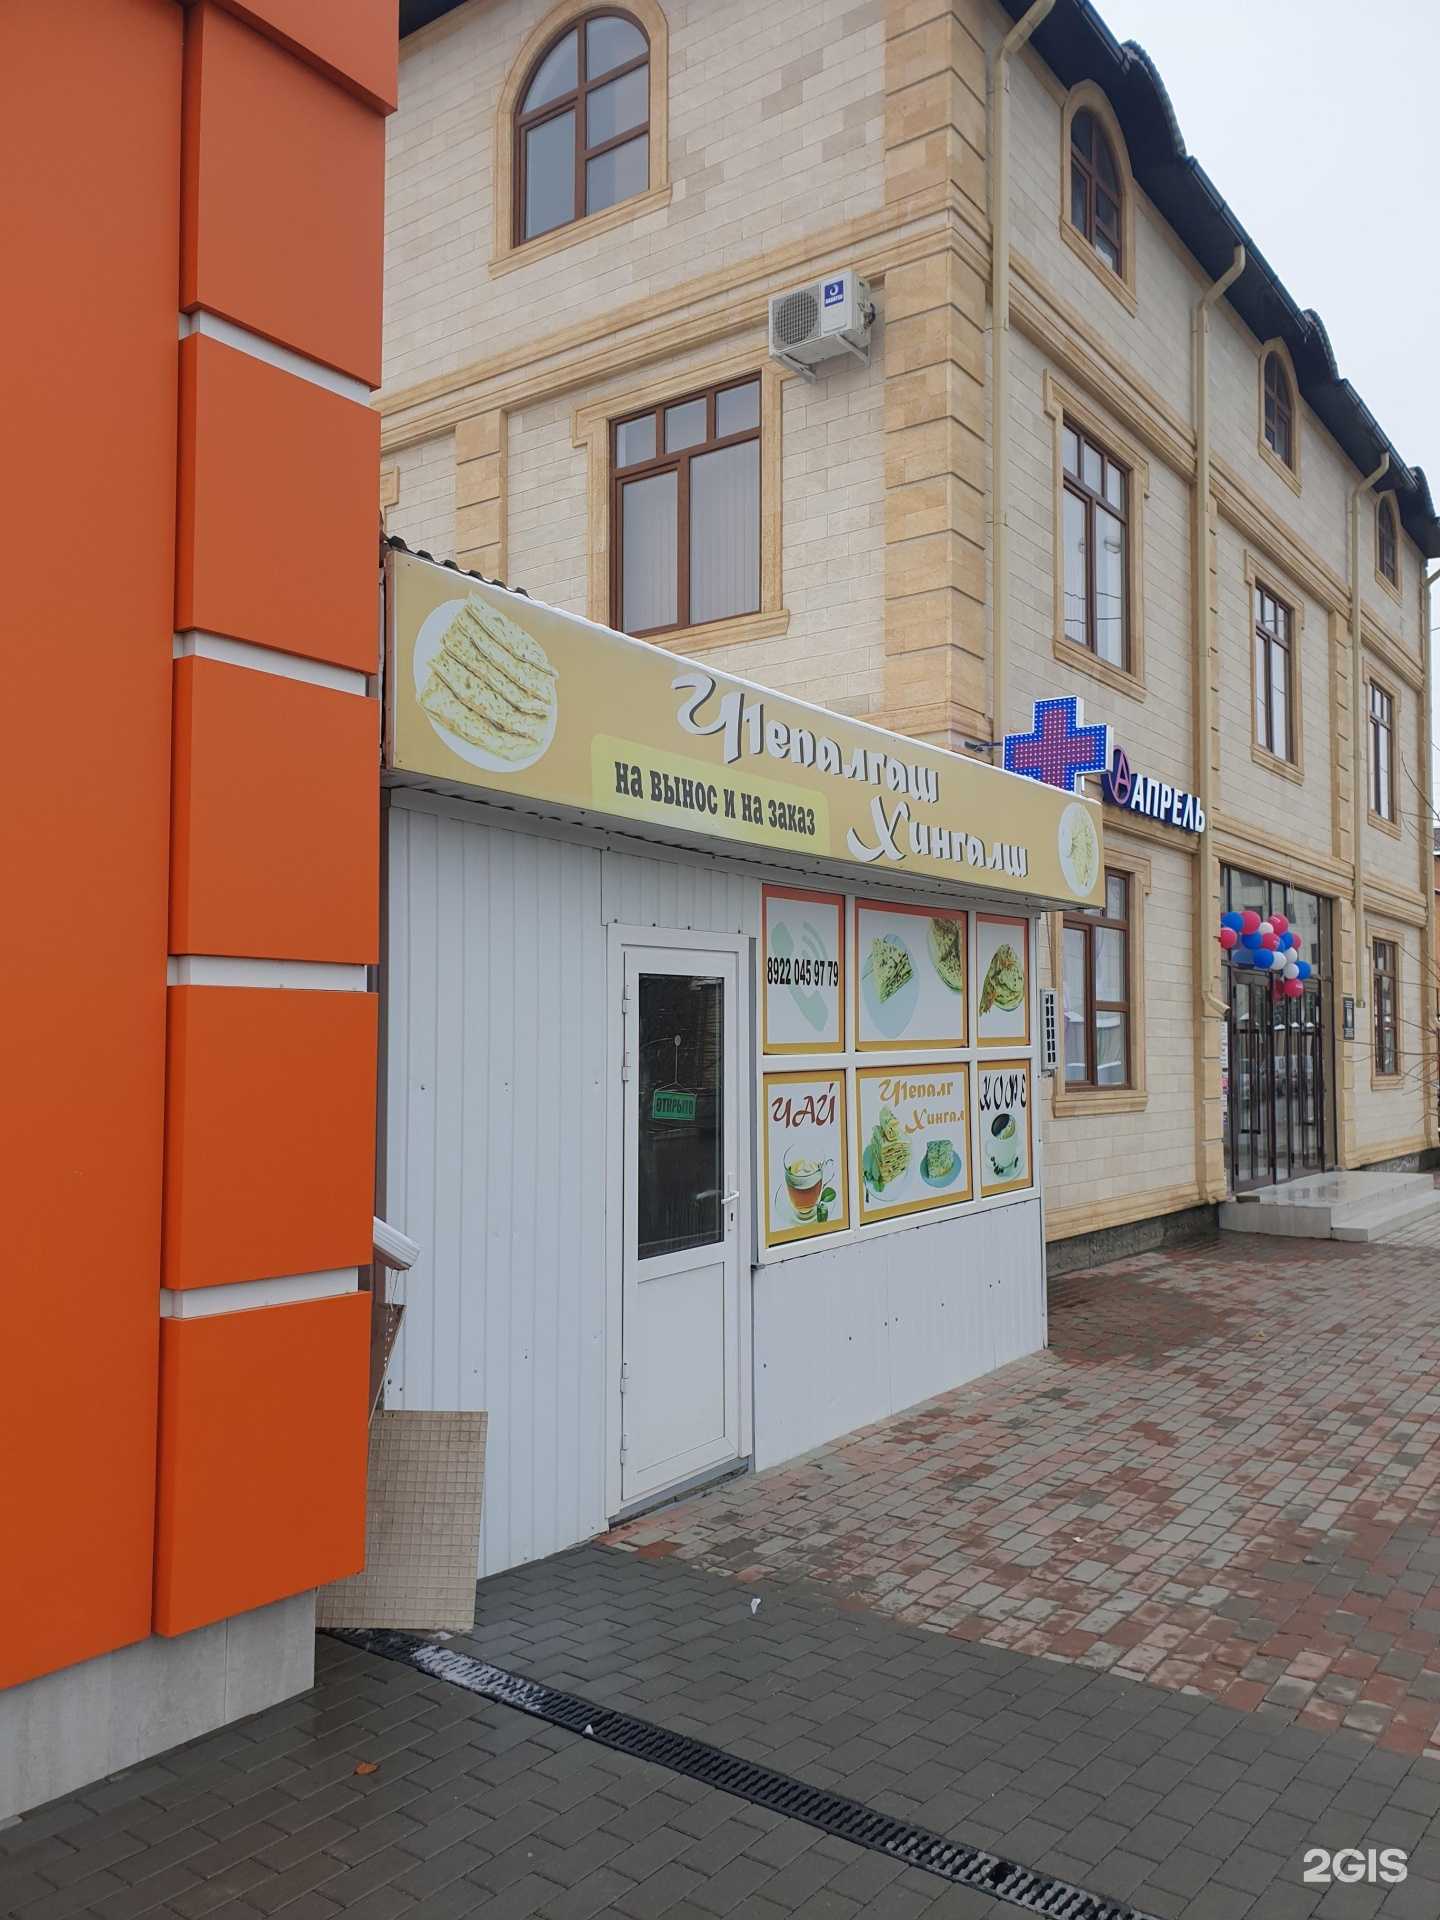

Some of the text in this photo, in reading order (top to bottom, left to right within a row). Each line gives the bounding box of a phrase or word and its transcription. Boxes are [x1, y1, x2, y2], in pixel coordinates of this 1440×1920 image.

[615, 761, 816, 836] на вынос и на заказ
[1130, 773, 1206, 833] АПРЕЛЬ
[847, 795, 1029, 878] Хингалш
[767, 957, 839, 987] 8922 045 97 79
[772, 1083, 836, 1128] ЧАЙ
